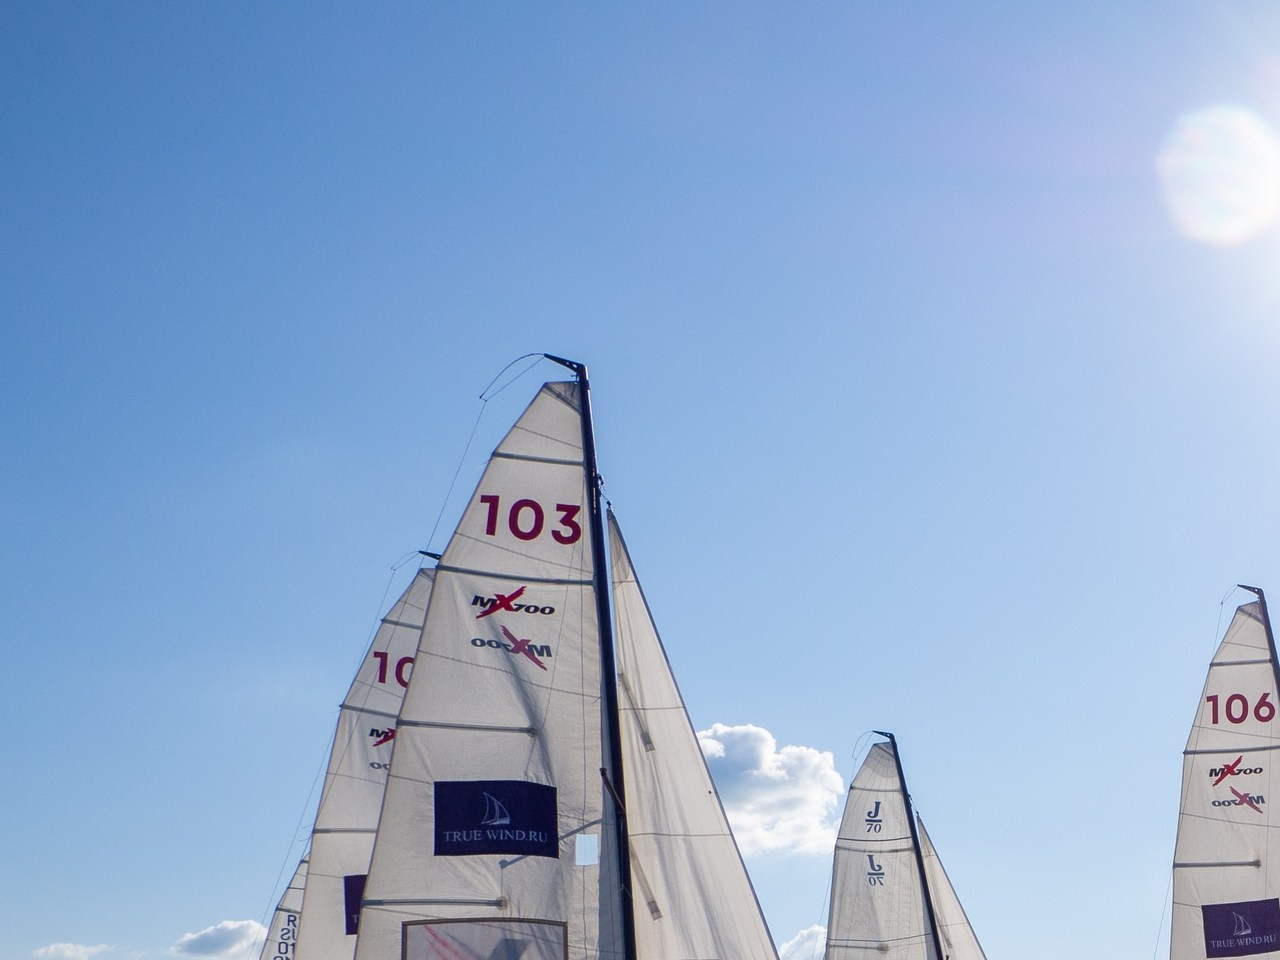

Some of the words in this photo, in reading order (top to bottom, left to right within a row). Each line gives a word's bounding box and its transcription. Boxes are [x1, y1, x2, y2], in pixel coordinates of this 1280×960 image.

[480, 494, 582, 545] 103
[373, 651, 415, 689] 10
[1206, 693, 1276, 725] 106
[443, 830, 482, 842] TRUE
[486, 829, 548, 843] WIND.RU
[1210, 939, 1235, 949] TRUE
